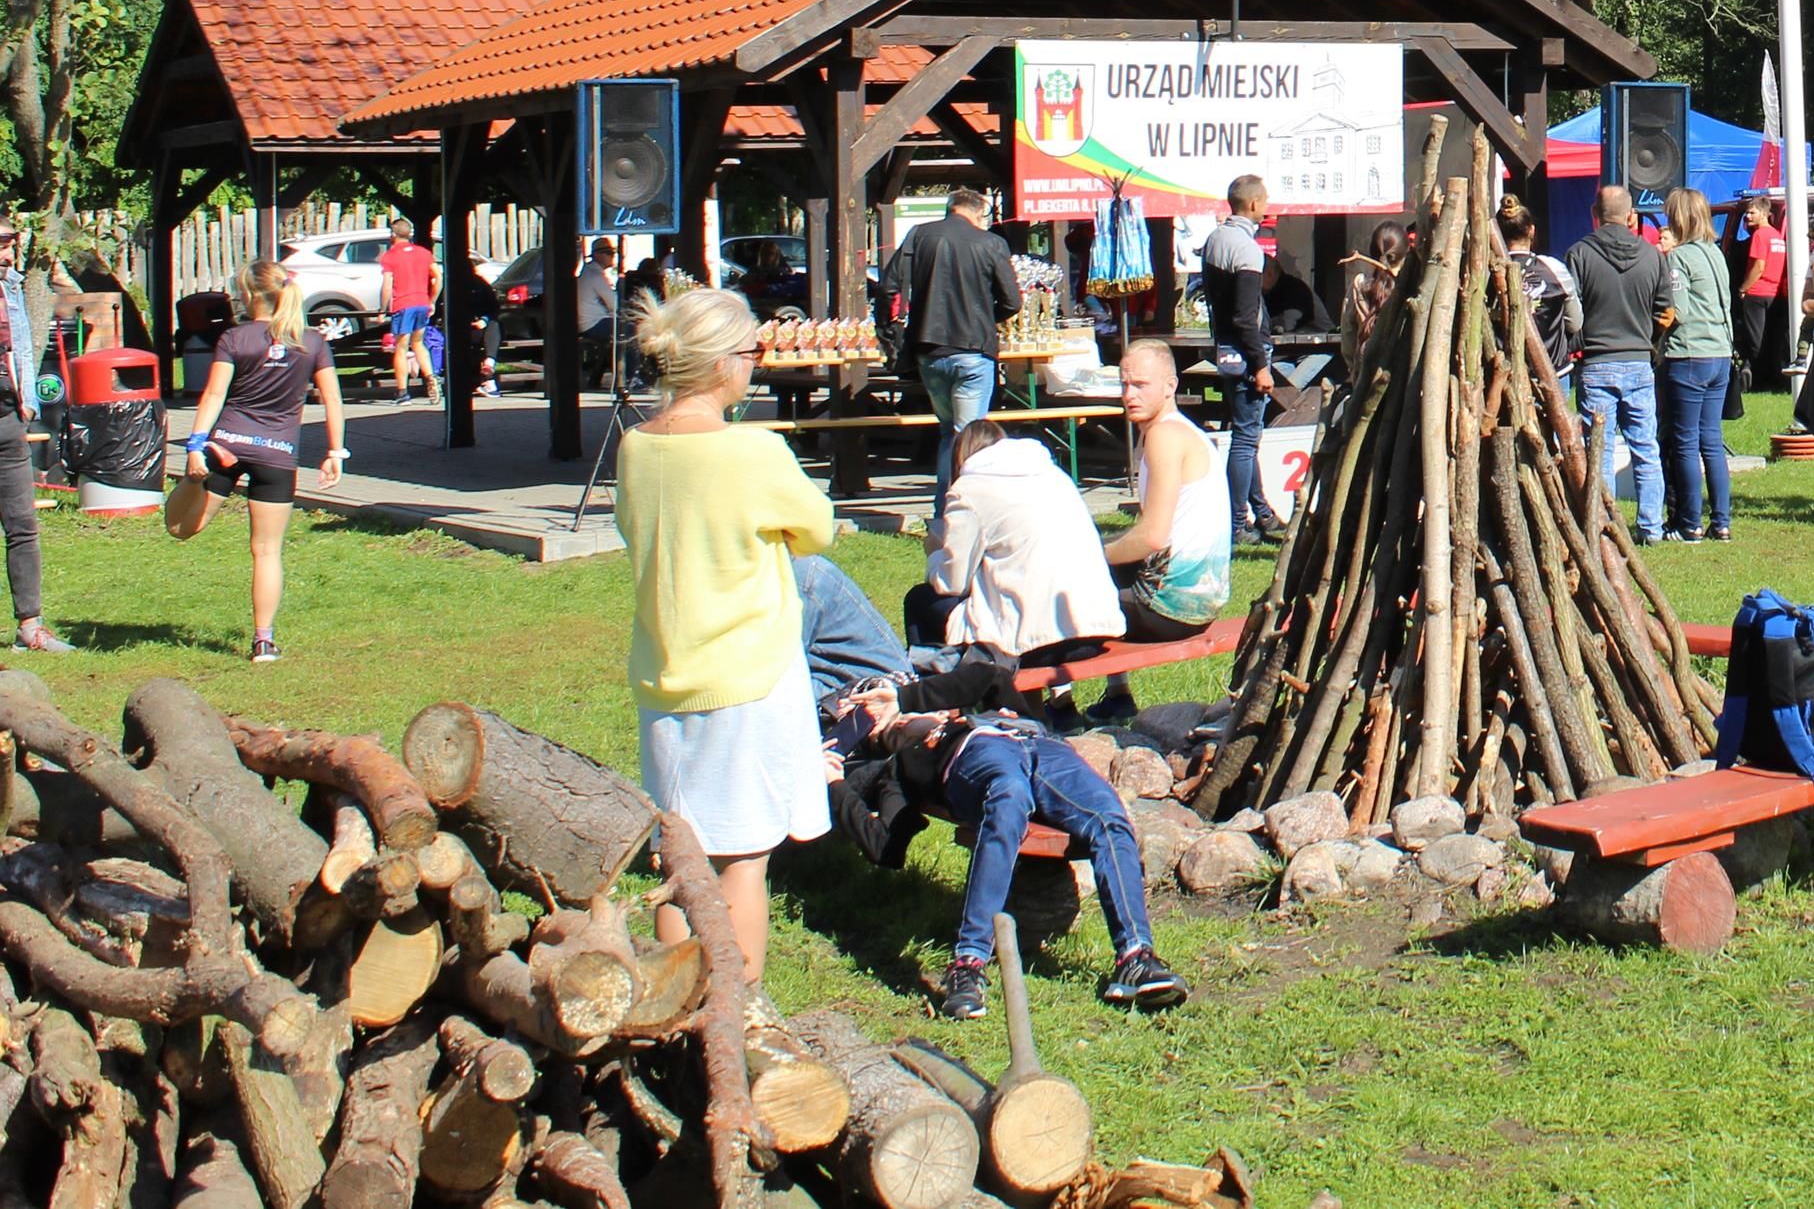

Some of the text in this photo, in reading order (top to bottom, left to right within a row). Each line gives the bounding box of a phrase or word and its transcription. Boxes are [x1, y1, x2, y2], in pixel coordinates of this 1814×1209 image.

[1107, 63, 1299, 106] URZĄD MIEJSKI
[1148, 123, 1259, 157] W LIPNIE
[1220, 353, 1242, 364] FILA
[1282, 450, 1311, 492] 2
